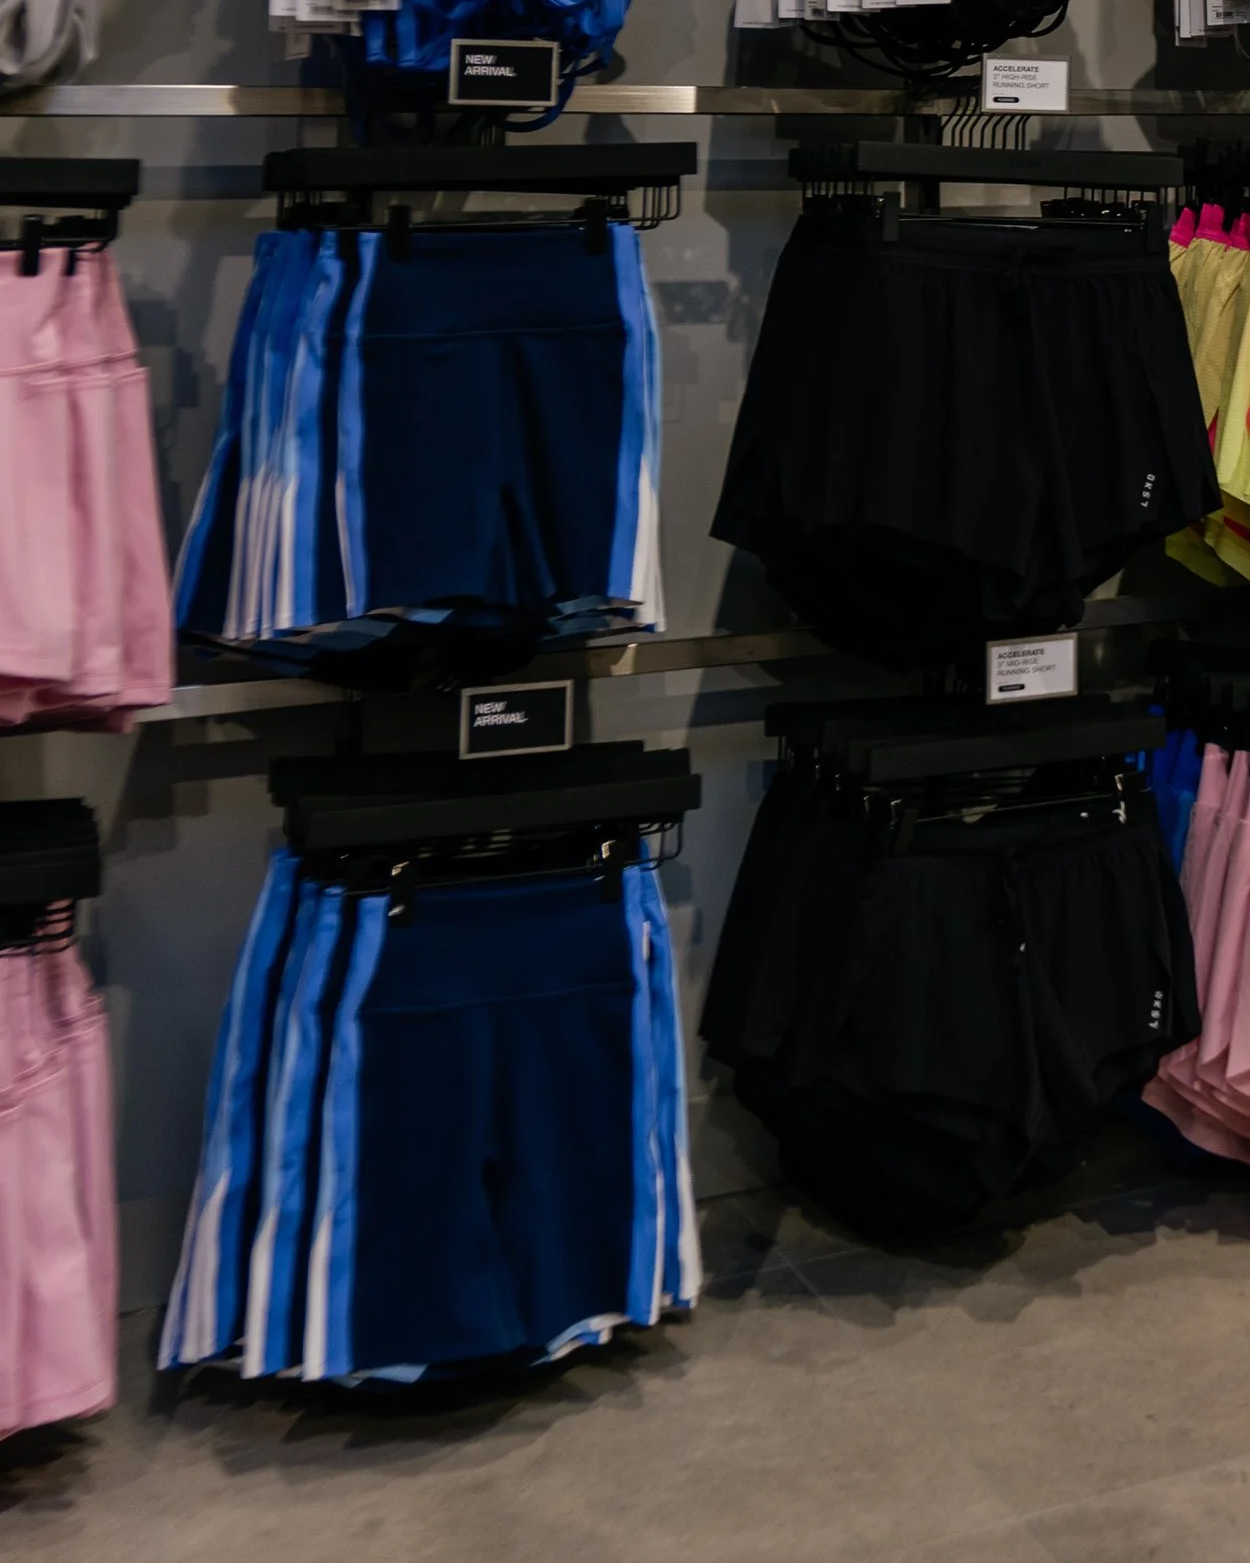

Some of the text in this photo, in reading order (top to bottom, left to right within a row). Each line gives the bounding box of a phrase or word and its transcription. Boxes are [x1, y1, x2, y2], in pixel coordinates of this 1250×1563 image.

[465, 54, 497, 65] NEW
[464, 66, 517, 77] ARRIVAL
[993, 65, 1040, 73] ACCELERATE
[993, 81, 1050, 90] RUNNING SHORT
[998, 648, 1045, 660] ACCELERATE
[998, 663, 1056, 677] RUNNING SHORT
[474, 700, 508, 716] NEW
[473, 711, 529, 728] ARRIVAL
